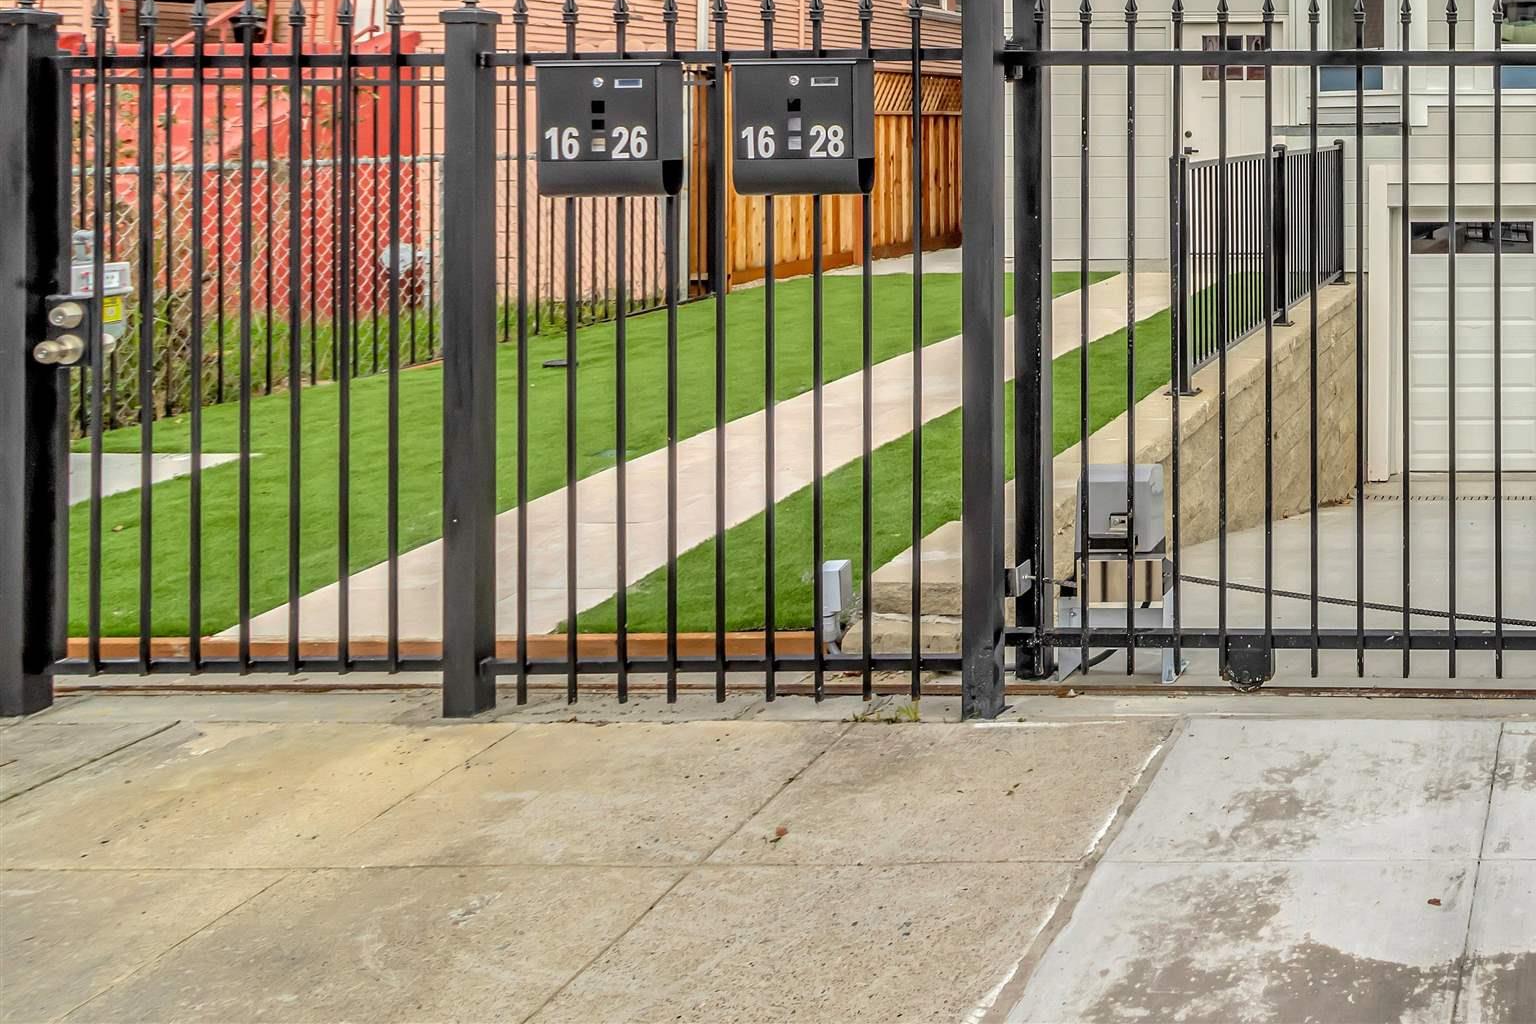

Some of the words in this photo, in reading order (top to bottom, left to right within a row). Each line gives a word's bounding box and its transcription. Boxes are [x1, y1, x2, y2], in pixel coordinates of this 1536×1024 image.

[544, 127, 580, 160] 16
[611, 126, 648, 159] 26
[741, 126, 775, 159] 16
[809, 125, 845, 158] 28
